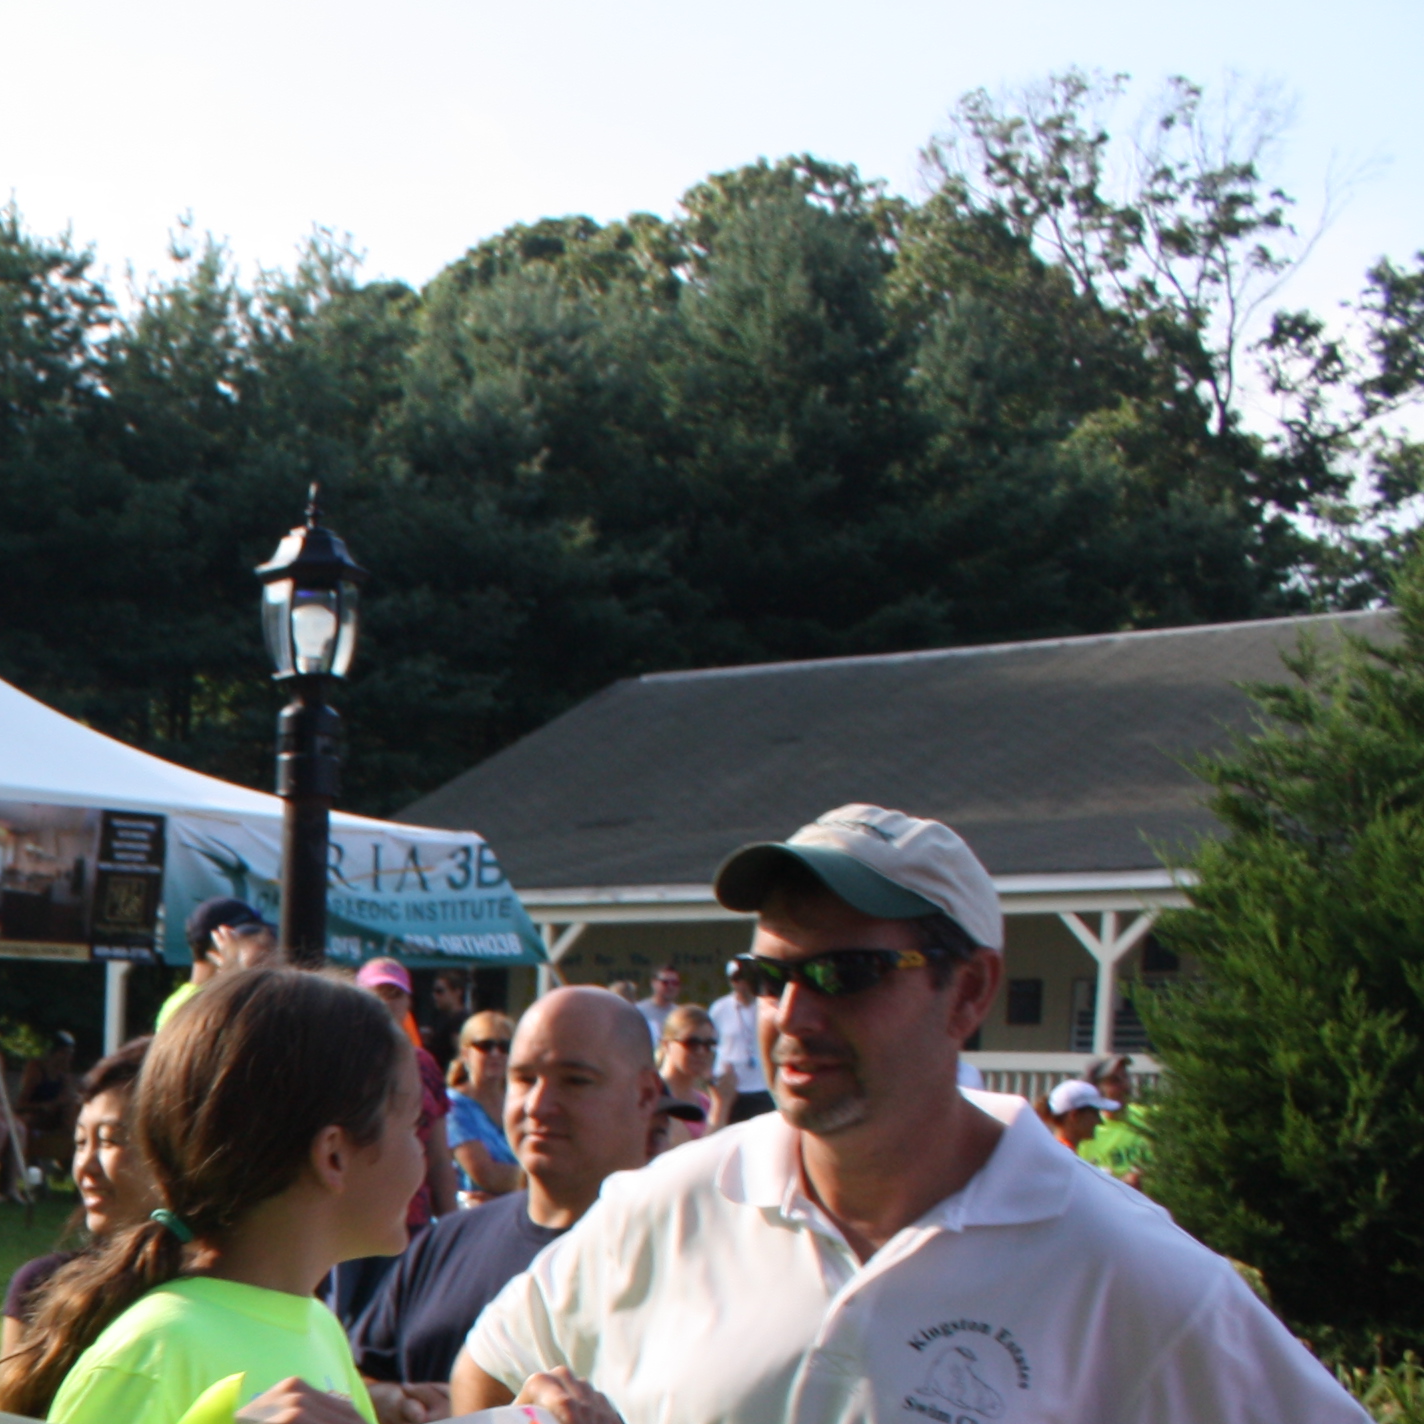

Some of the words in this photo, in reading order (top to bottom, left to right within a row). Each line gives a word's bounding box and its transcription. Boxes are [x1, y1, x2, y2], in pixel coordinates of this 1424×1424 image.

[405, 896, 514, 922] INSTITUTE
[907, 1318, 991, 1352] Kingston
[902, 1395, 952, 1424] Swim
